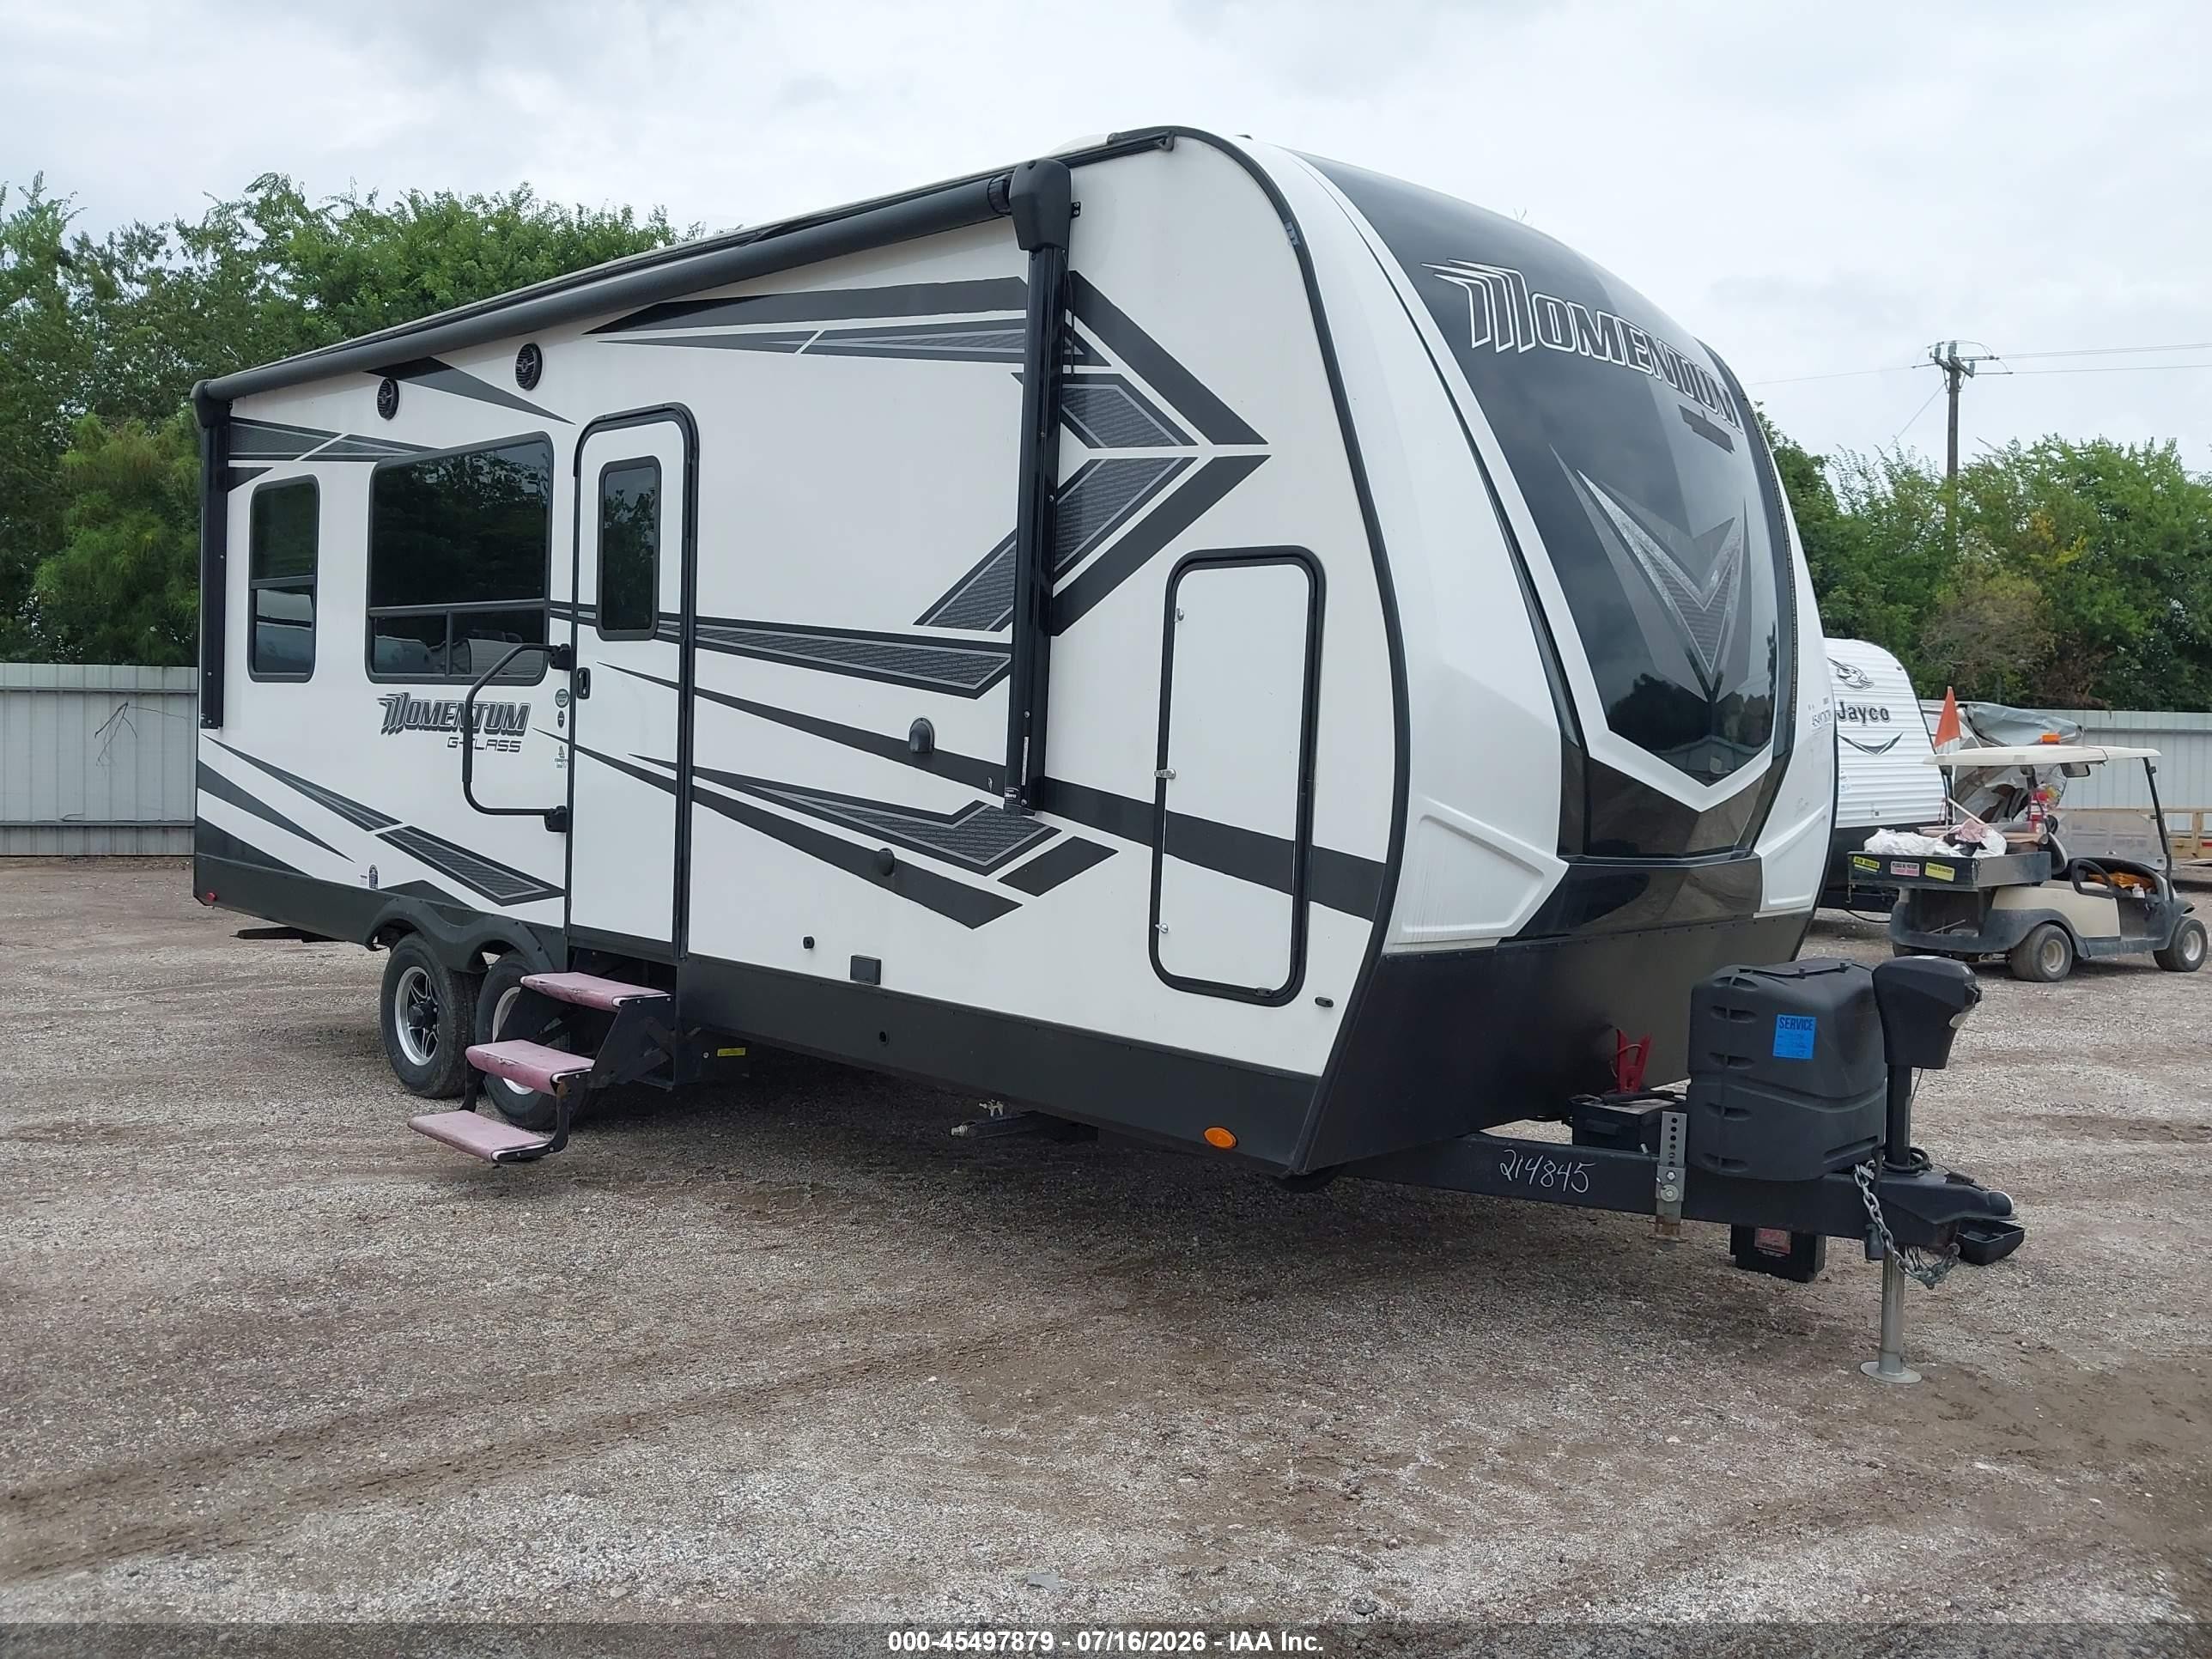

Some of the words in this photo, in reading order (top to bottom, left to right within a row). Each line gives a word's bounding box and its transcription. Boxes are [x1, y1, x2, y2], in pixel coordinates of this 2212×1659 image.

[1420, 258, 1744, 435] MOMENTUM
[1836, 699, 1891, 726] Jayco
[447, 736, 522, 753] G-LASS
[1778, 1016, 1814, 1031] SERVICE
[1499, 1149, 1596, 1194] 214845
